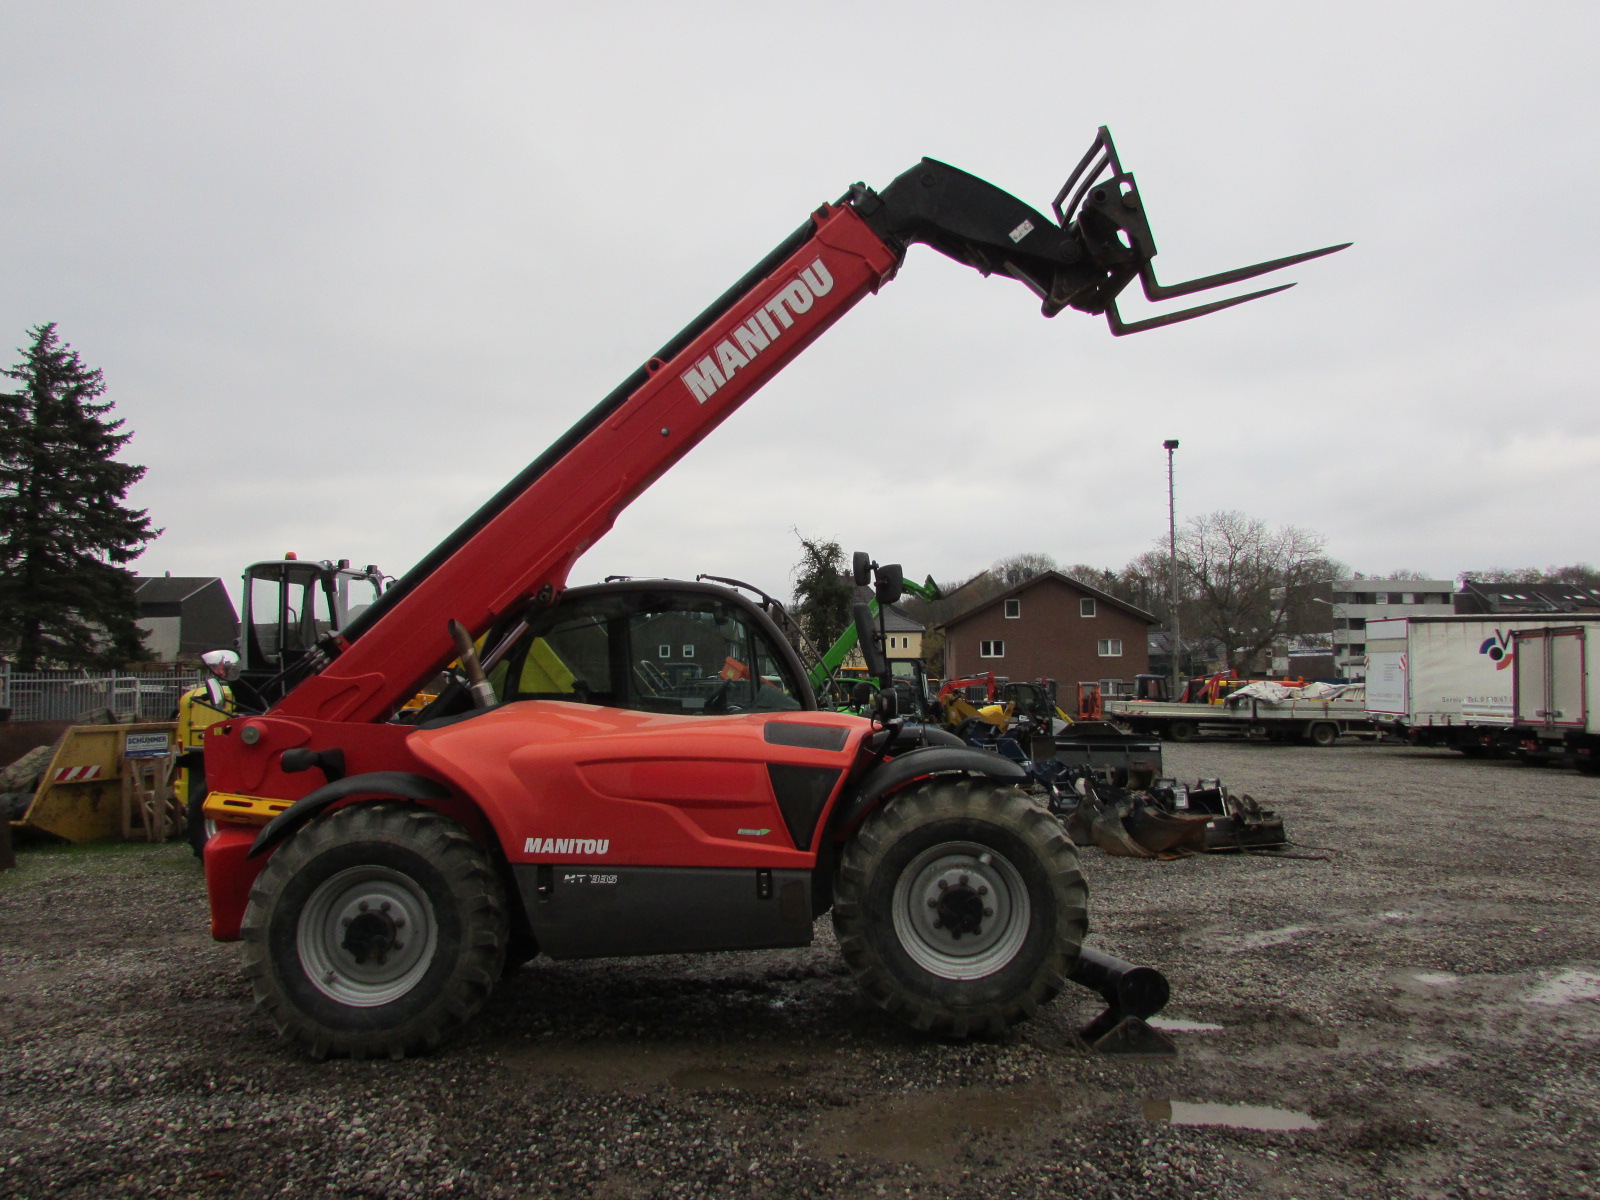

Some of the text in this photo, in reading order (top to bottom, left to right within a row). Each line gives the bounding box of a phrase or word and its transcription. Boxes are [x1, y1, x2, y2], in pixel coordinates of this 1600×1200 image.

[682, 257, 834, 405] MANITOU
[524, 837, 609, 854] MANITOU
[589, 874, 618, 884] 335
